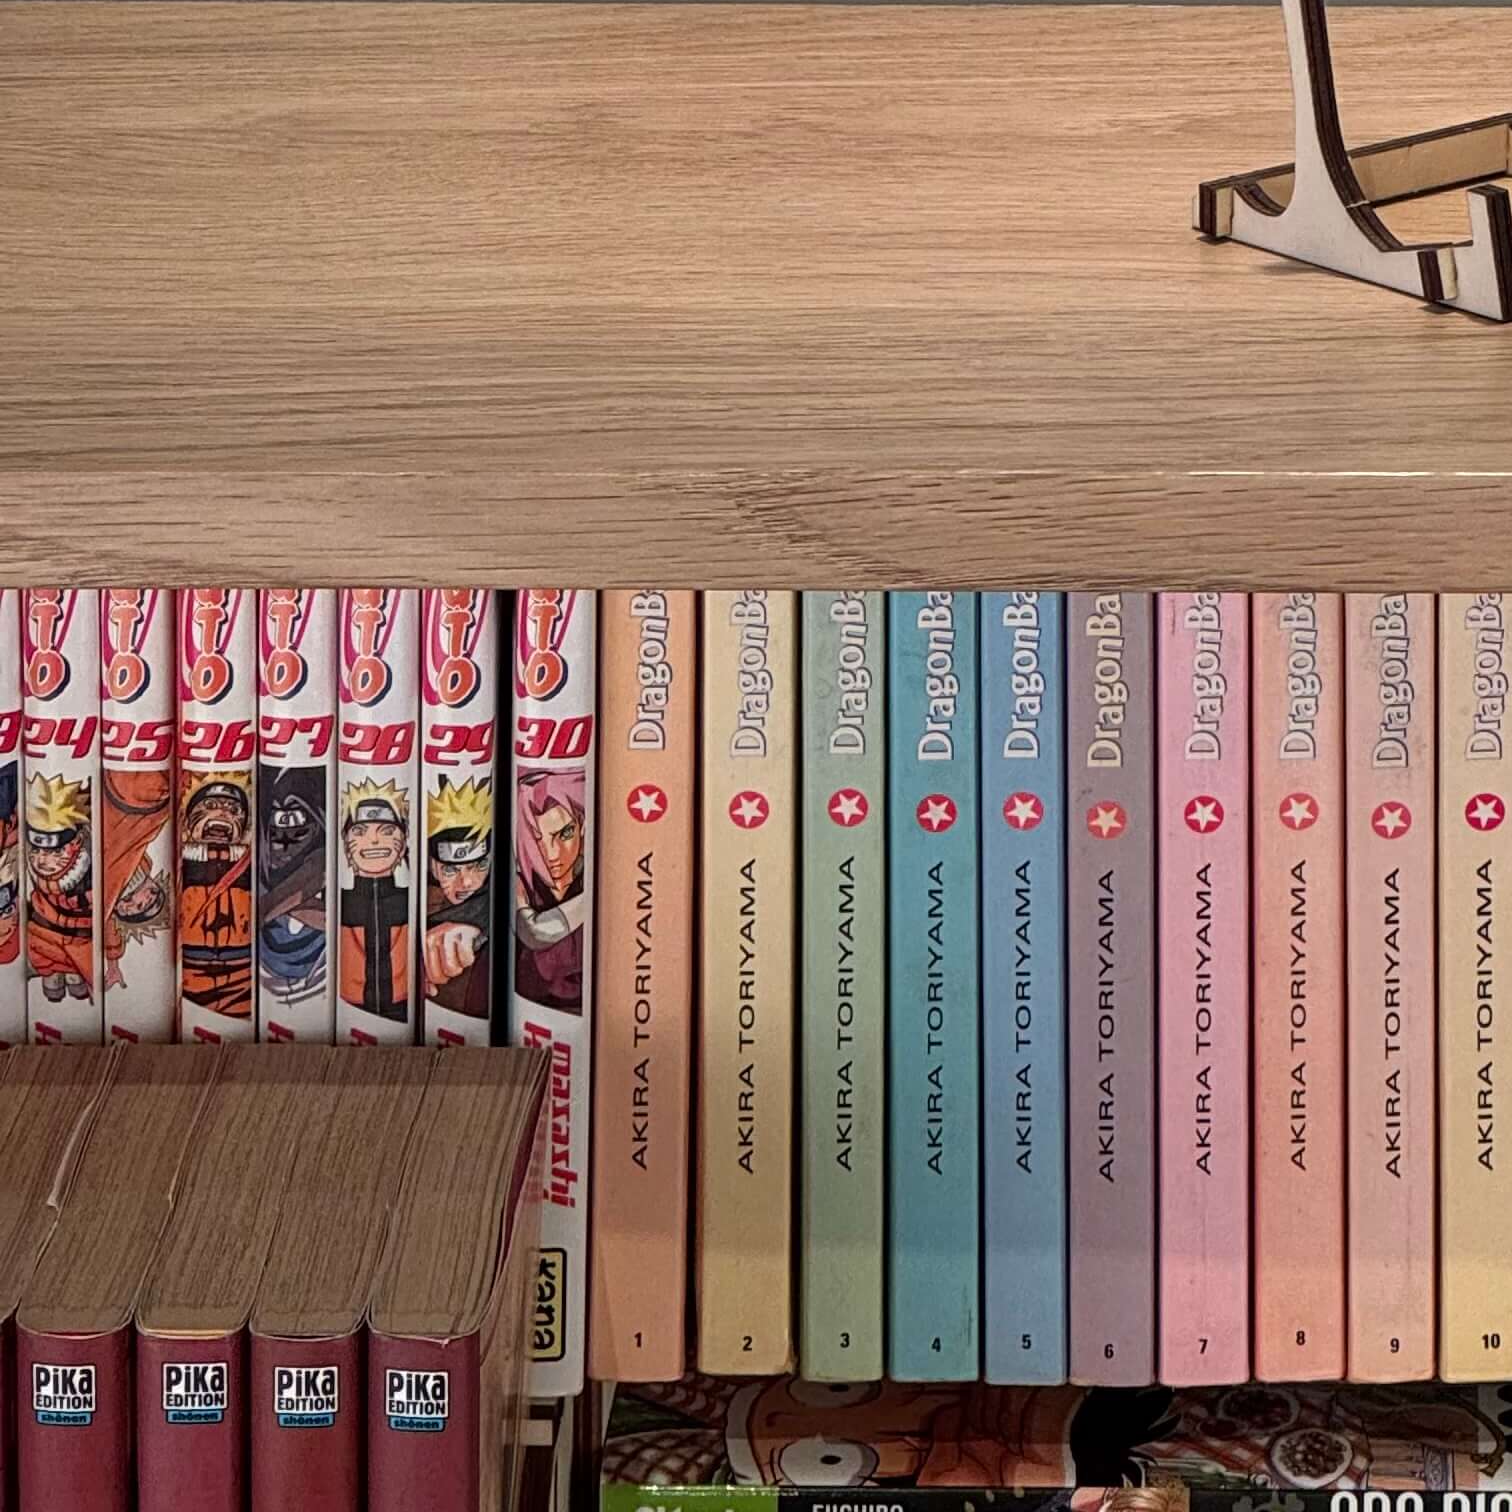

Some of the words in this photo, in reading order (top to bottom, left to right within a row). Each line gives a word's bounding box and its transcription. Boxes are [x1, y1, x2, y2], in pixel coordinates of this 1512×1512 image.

[628, 589, 671, 750] DragonB
[917, 591, 960, 760] DragonBa
[1086, 592, 1129, 768] DragonBa
[1184, 592, 1227, 760] DragonBa
[1279, 592, 1322, 760] DragonBa
[1371, 593, 1414, 768] DragonBa
[1465, 593, 1508, 760] DragonBa
[24, 716, 98, 759] 24
[102, 718, 175, 762] 25
[178, 719, 255, 763] 26
[261, 714, 334, 757] 27
[339, 721, 416, 765] 28
[424, 717, 496, 766] 29
[514, 714, 594, 759] 30
[633, 851, 654, 1049] TORIYAMA
[738, 858, 756, 1055] TORIYAMA
[836, 855, 855, 1051] TORIYAMA
[927, 860, 944, 1056] TORIYAMA
[1014, 859, 1032, 1054] TORIYAMA
[1097, 869, 1115, 1063] TORIYAMA
[1195, 862, 1212, 1057] TORIYAMA
[1290, 859, 1307, 1053] TORIYAMA
[1383, 867, 1401, 1061] TORIYAMA
[1476, 858, 1493, 1053] TORIYAMA
[631, 1057, 650, 1171] AKIRA
[737, 1063, 755, 1175] AKIRA
[836, 1060, 853, 1173] AKIRA
[926, 1064, 944, 1176] AKIRA
[1015, 1063, 1033, 1175] AKIRA
[1097, 1072, 1115, 1184] AKIRA
[1195, 1065, 1212, 1177] AKIRA
[1290, 1061, 1307, 1172] AKIRA
[1385, 1069, 1401, 1179] AKIRA
[1477, 1061, 1494, 1172] AKIRA
[634, 1331, 642, 1348] 1
[742, 1335, 753, 1352] 2
[839, 1332, 850, 1349] 3
[931, 1336, 942, 1353] 4
[1021, 1333, 1032, 1350] 5
[1103, 1343, 1115, 1360] 6
[1198, 1338, 1209, 1355] 7
[1295, 1330, 1306, 1347] 8
[1389, 1337, 1400, 1354] 9
[1481, 1333, 1501, 1350] 10
[36, 1395, 93, 1409] EDITION
[166, 1393, 225, 1407] EDITION
[277, 1397, 336, 1411] EDITION
[389, 1400, 446, 1415] EDITION
